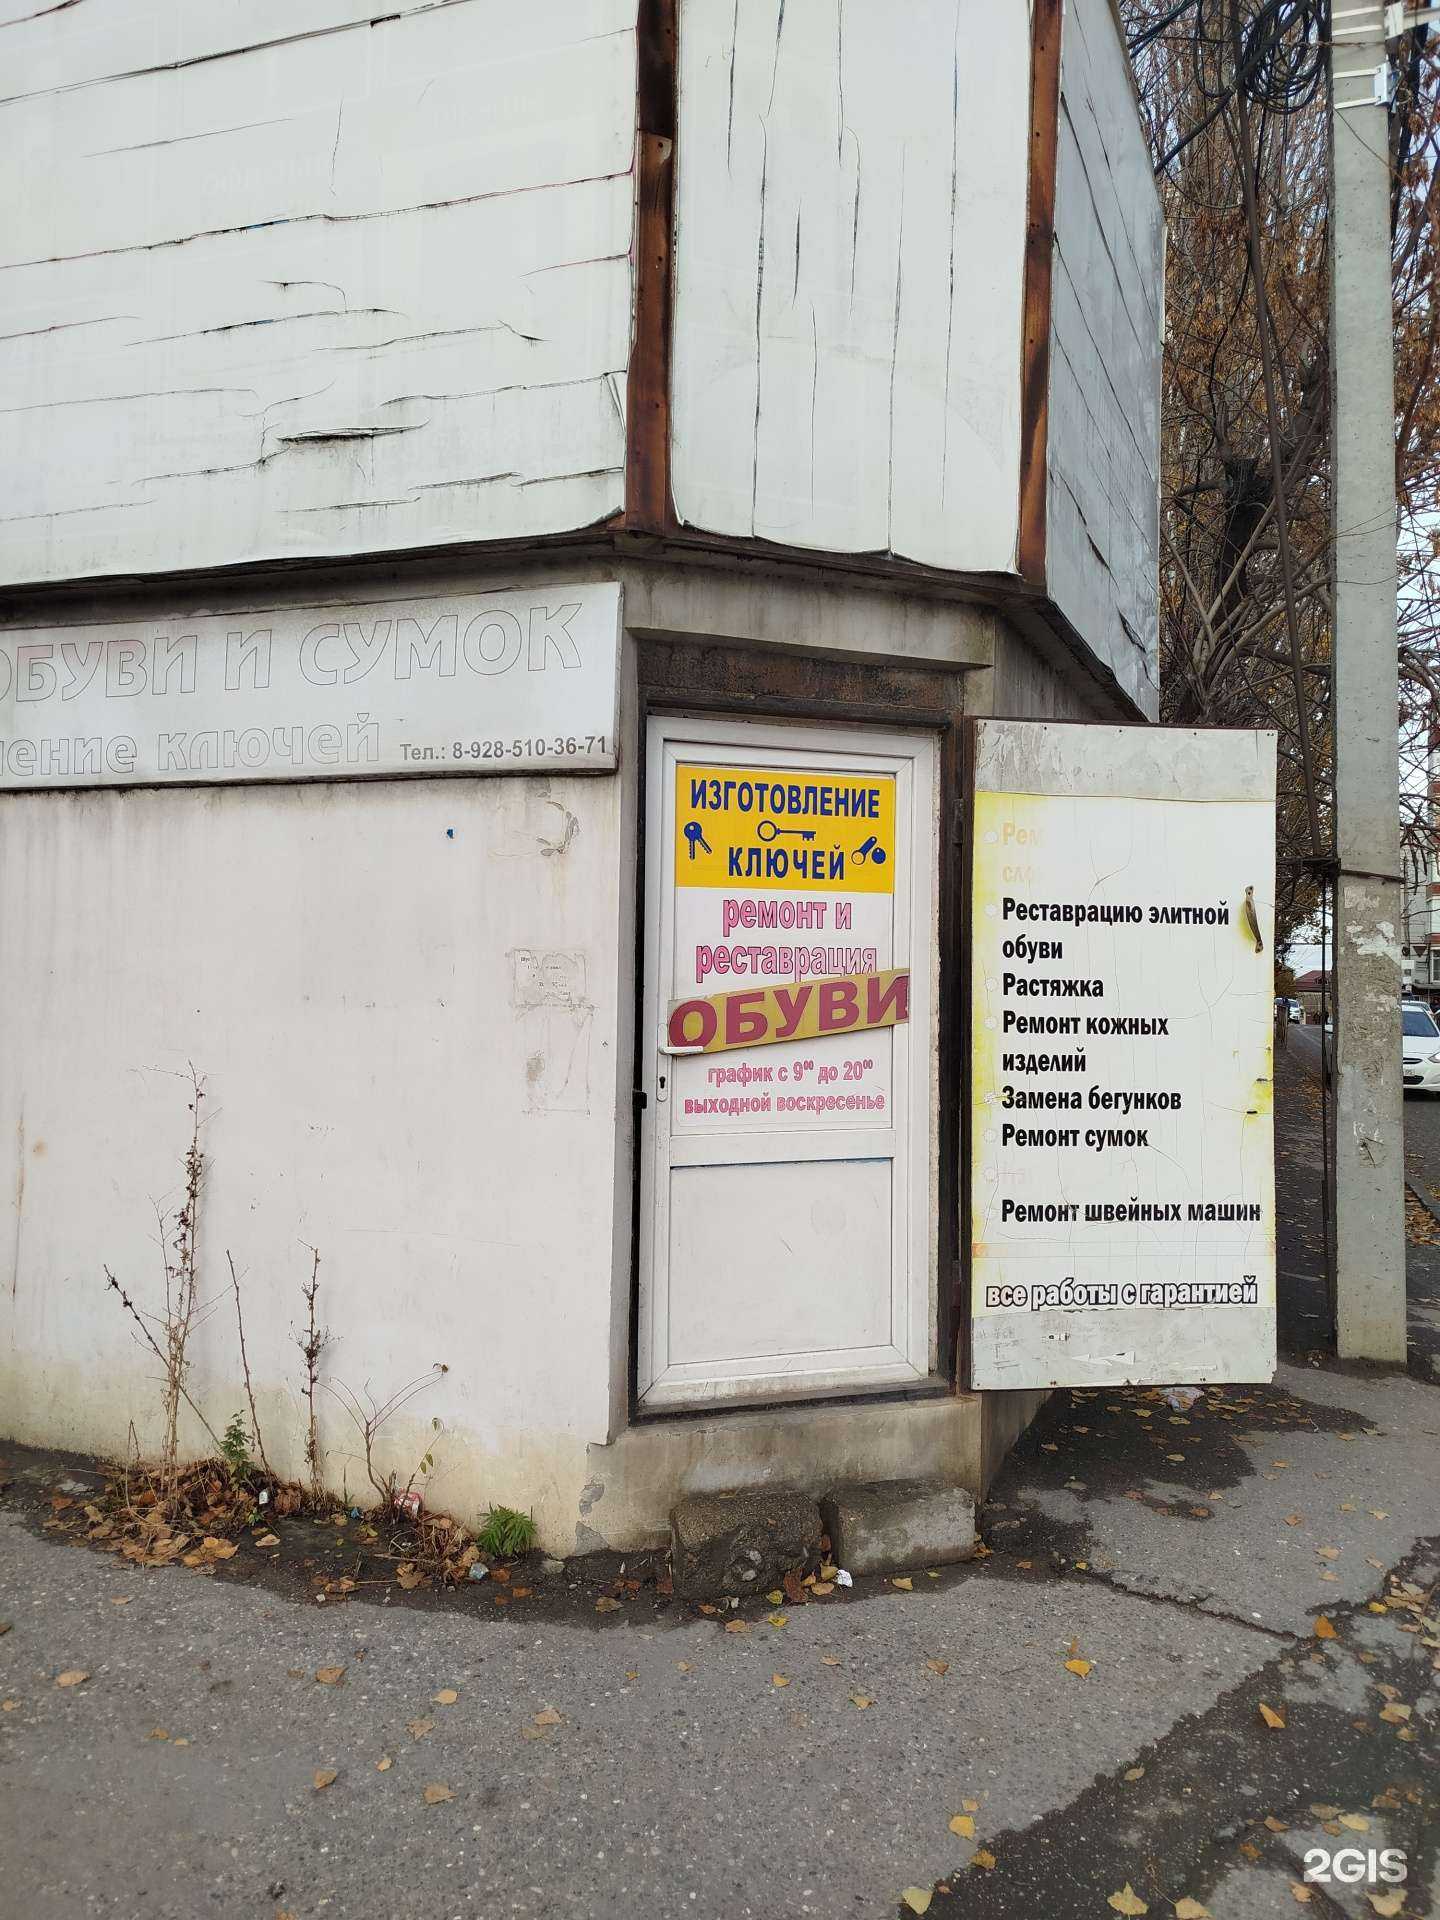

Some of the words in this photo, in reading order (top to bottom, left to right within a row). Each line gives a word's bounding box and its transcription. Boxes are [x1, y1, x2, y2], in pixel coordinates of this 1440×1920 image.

[0, 634, 198, 702] БУВИ
[224, 629, 273, 691] И
[300, 603, 582, 685] СУМОК
[158, 713, 380, 771] ключей
[400, 743, 446, 761] Тел.:
[452, 736, 607, 760] 8-928-510-36-71
[690, 779, 880, 818] ИЗГОТОВЛЕНИЕ
[728, 844, 845, 880] КЛЮЧЕЙ
[722, 899, 827, 937] ремонт
[835, 902, 852, 930] и
[1003, 898, 1143, 927] Реставрацию
[1149, 900, 1229, 925] элитной
[1003, 934, 1063, 964] обуви
[695, 945, 877, 983] реставрация
[1003, 973, 1104, 998] Растяжка
[667, 975, 910, 1048] ОБУВИ
[1003, 1011, 1081, 1035] Ремонт
[1086, 1015, 1169, 1036] кожных
[707, 1063, 774, 1087] график
[778, 1067, 789, 1082] с
[817, 1066, 839, 1085] до
[1002, 1047, 1086, 1075] изделий
[684, 1092, 772, 1117] выходной
[776, 1094, 885, 1116] воскресенье
[1002, 1086, 1082, 1110] Замена
[1088, 1086, 1182, 1115] бегунков
[1002, 1123, 1080, 1147] Ремонт
[1085, 1129, 1149, 1152] сумок
[1002, 1199, 1079, 1222] Ремонт
[1085, 1196, 1181, 1222] швейных
[1188, 1203, 1261, 1221] машин
[986, 1284, 1028, 1307] все
[1031, 1277, 1118, 1311] работы
[1121, 1285, 1136, 1303] с
[1139, 1275, 1258, 1308] гарантией
